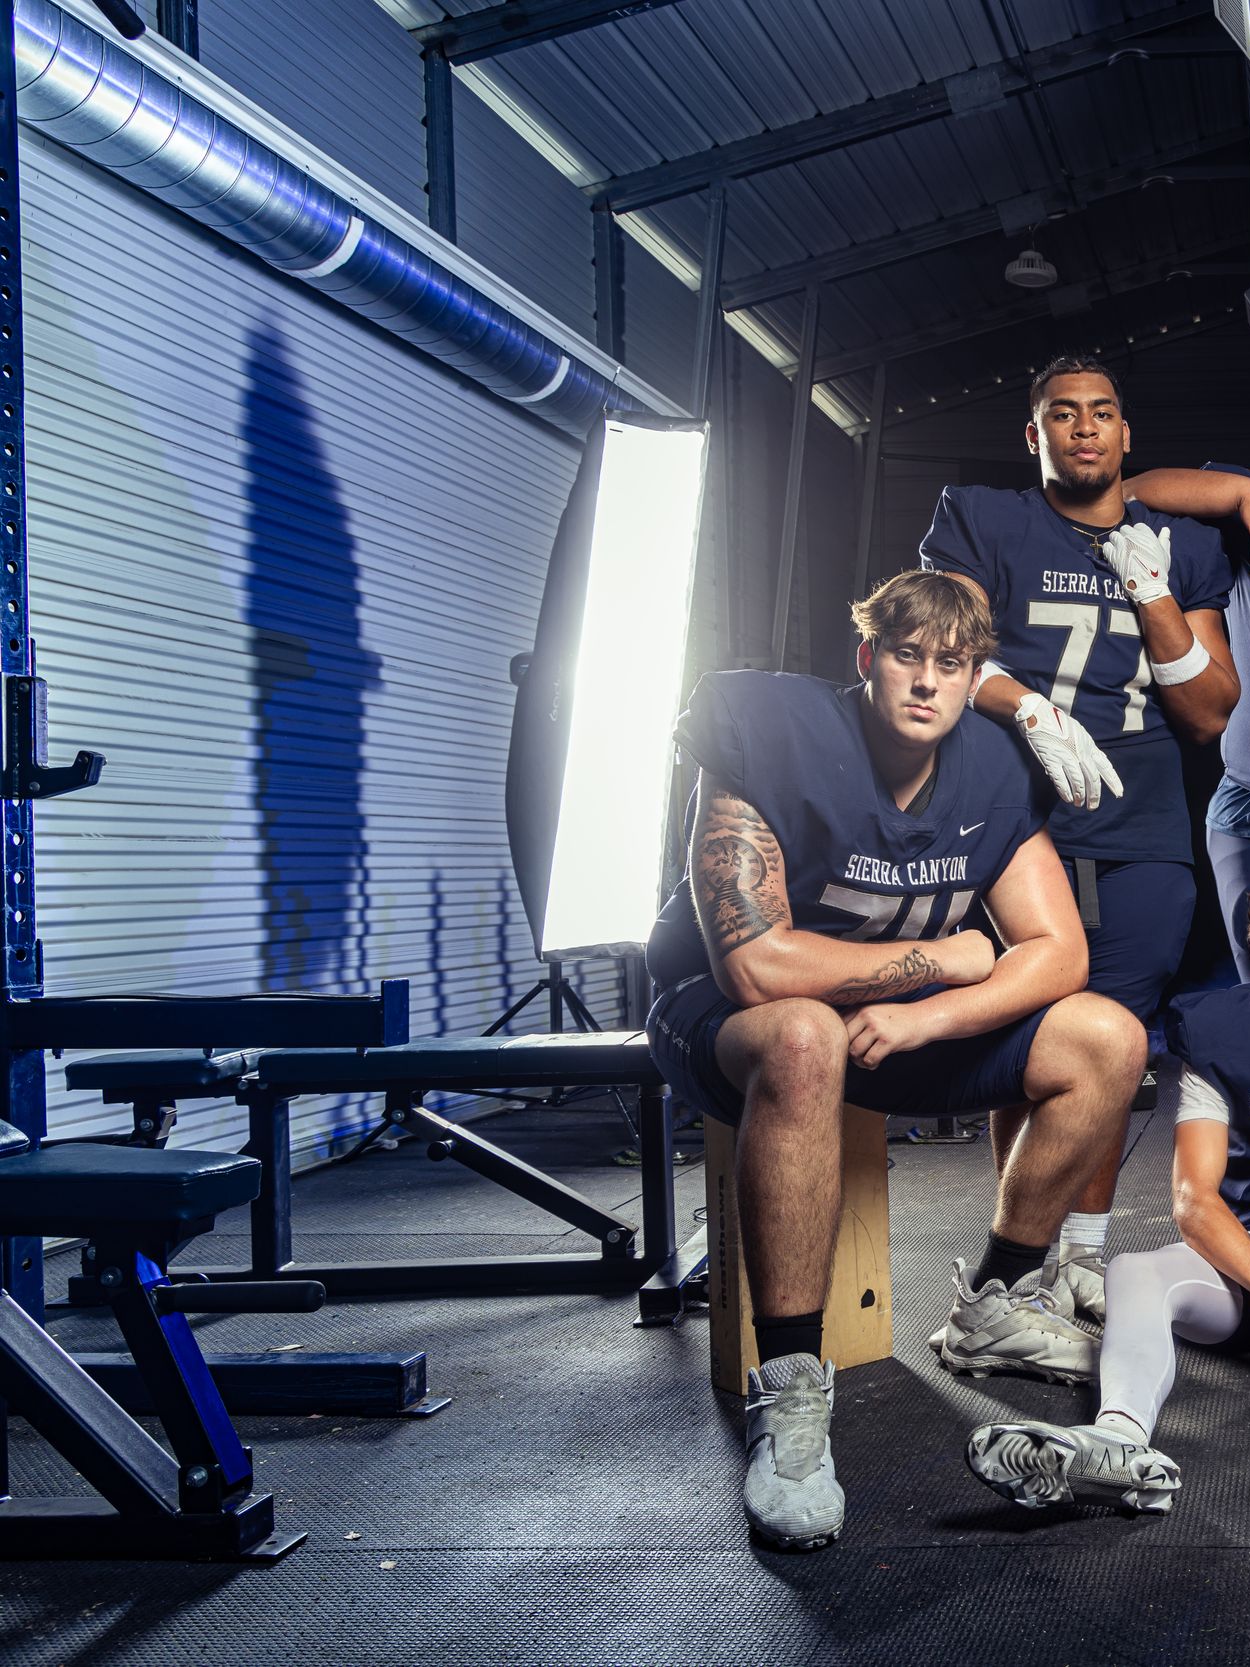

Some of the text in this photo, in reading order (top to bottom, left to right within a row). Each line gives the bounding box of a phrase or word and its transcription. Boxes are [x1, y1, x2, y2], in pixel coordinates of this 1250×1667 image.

[1042, 570, 1099, 595] SIERRA
[1026, 600, 1152, 732] 77
[844, 854, 968, 886] SIERRA CANYON
